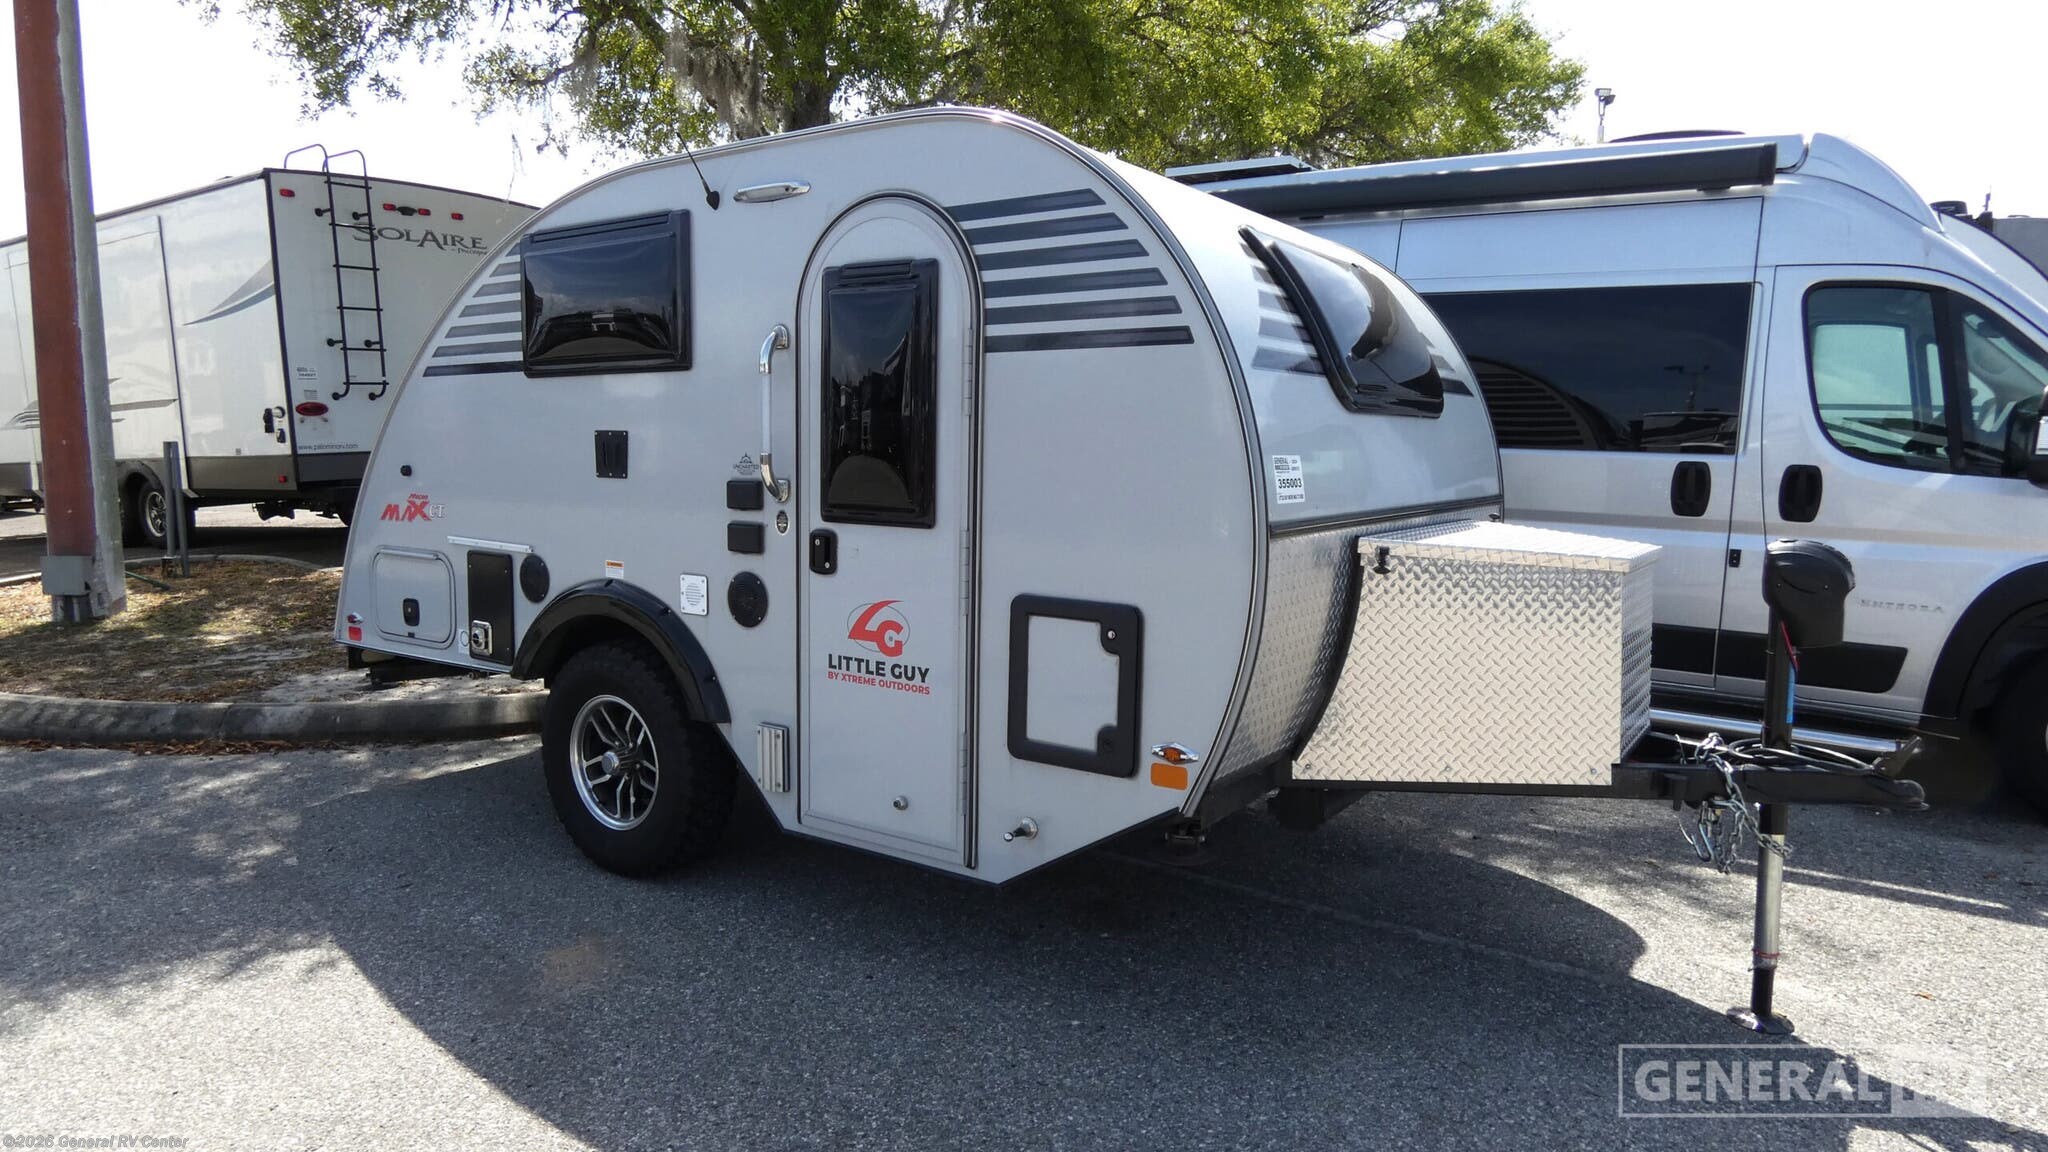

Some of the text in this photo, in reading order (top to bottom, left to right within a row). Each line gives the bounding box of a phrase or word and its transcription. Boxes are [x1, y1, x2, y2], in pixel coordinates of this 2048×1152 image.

[1278, 478, 1302, 489] 355003
[380, 500, 432, 522] MAX
[828, 653, 930, 683] LITTLE GUY
[828, 671, 930, 695] BY XTREME OUTDOORS
